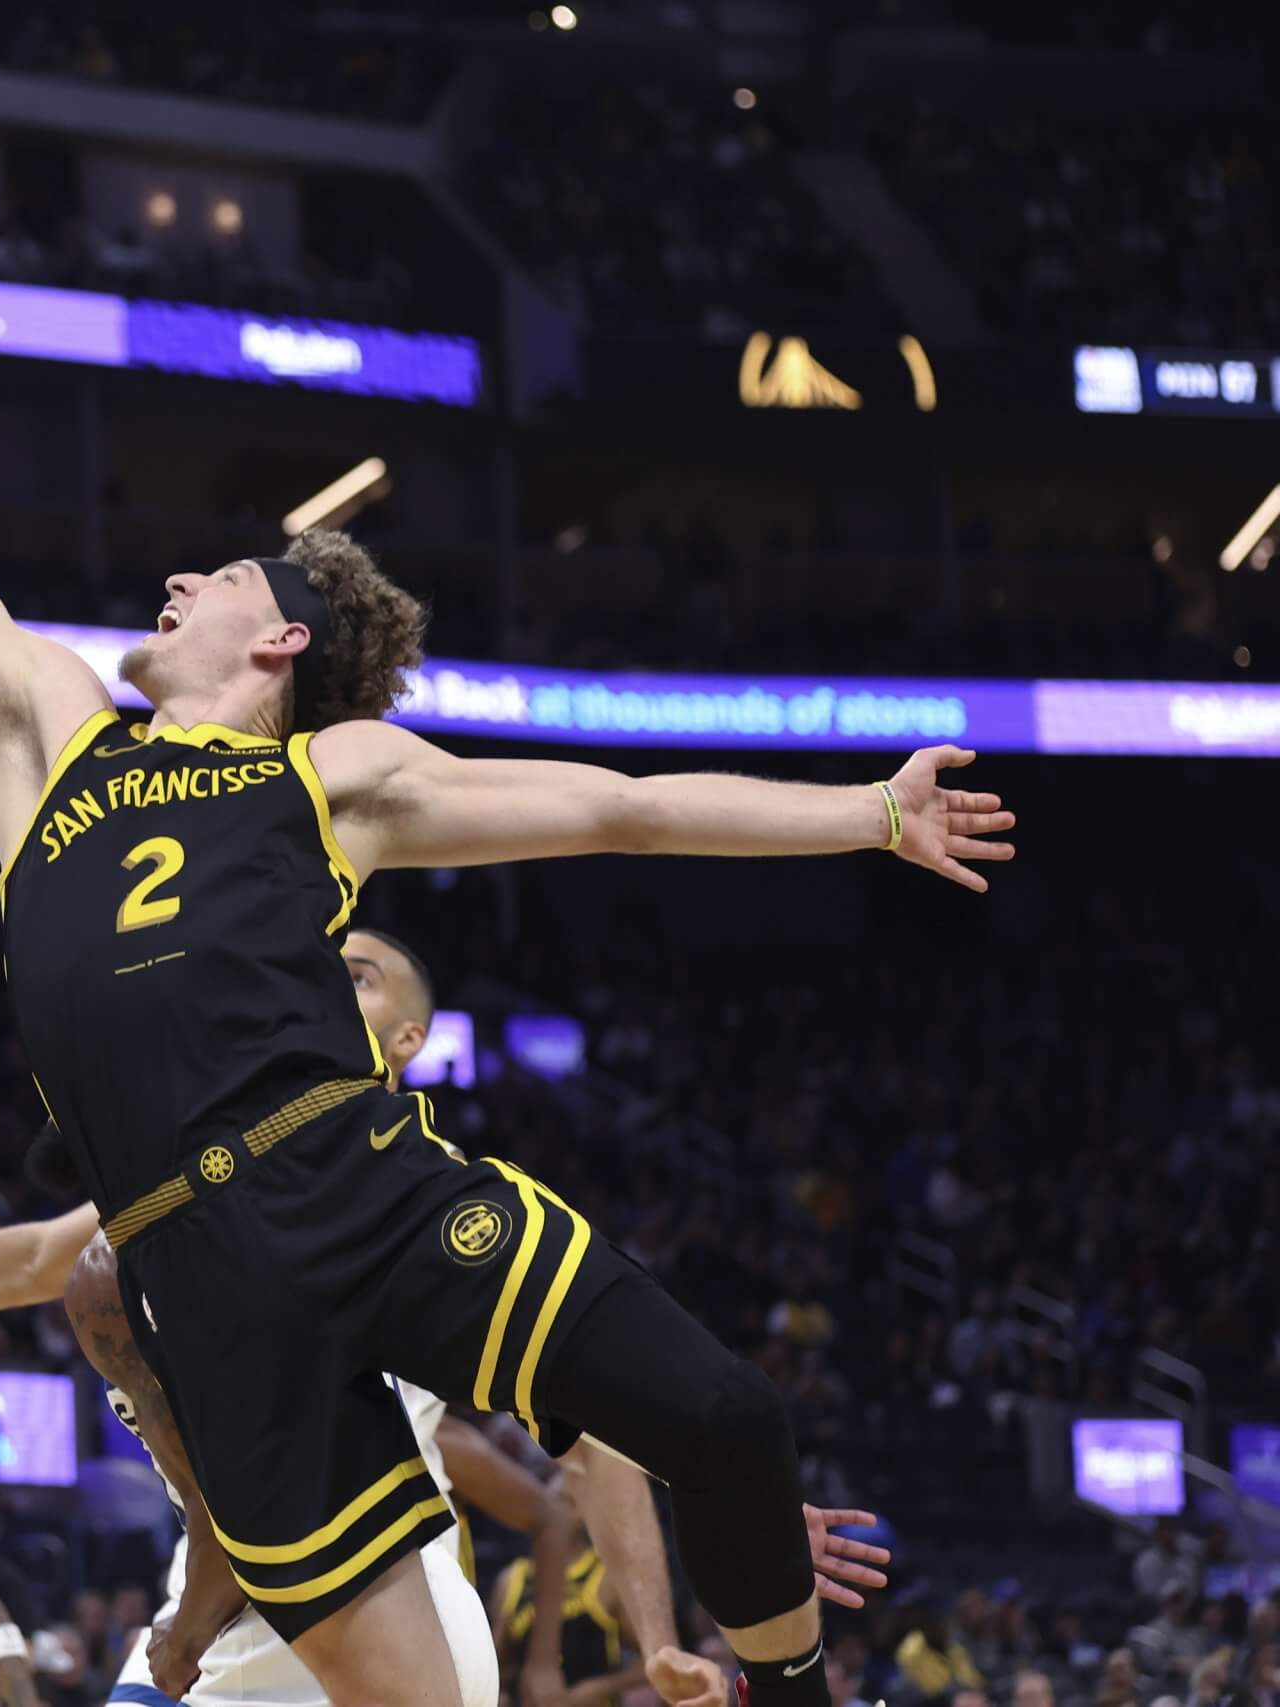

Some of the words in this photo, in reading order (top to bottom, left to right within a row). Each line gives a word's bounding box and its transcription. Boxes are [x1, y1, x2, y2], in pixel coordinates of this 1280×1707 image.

[435, 669, 527, 725] Back
[527, 682, 570, 729] at
[571, 682, 785, 736] thousands
[786, 686, 836, 736] of
[836, 690, 967, 738] stores
[41, 789, 106, 864] SAN
[106, 761, 285, 809] FRANCISCO
[116, 836, 185, 934] 2
